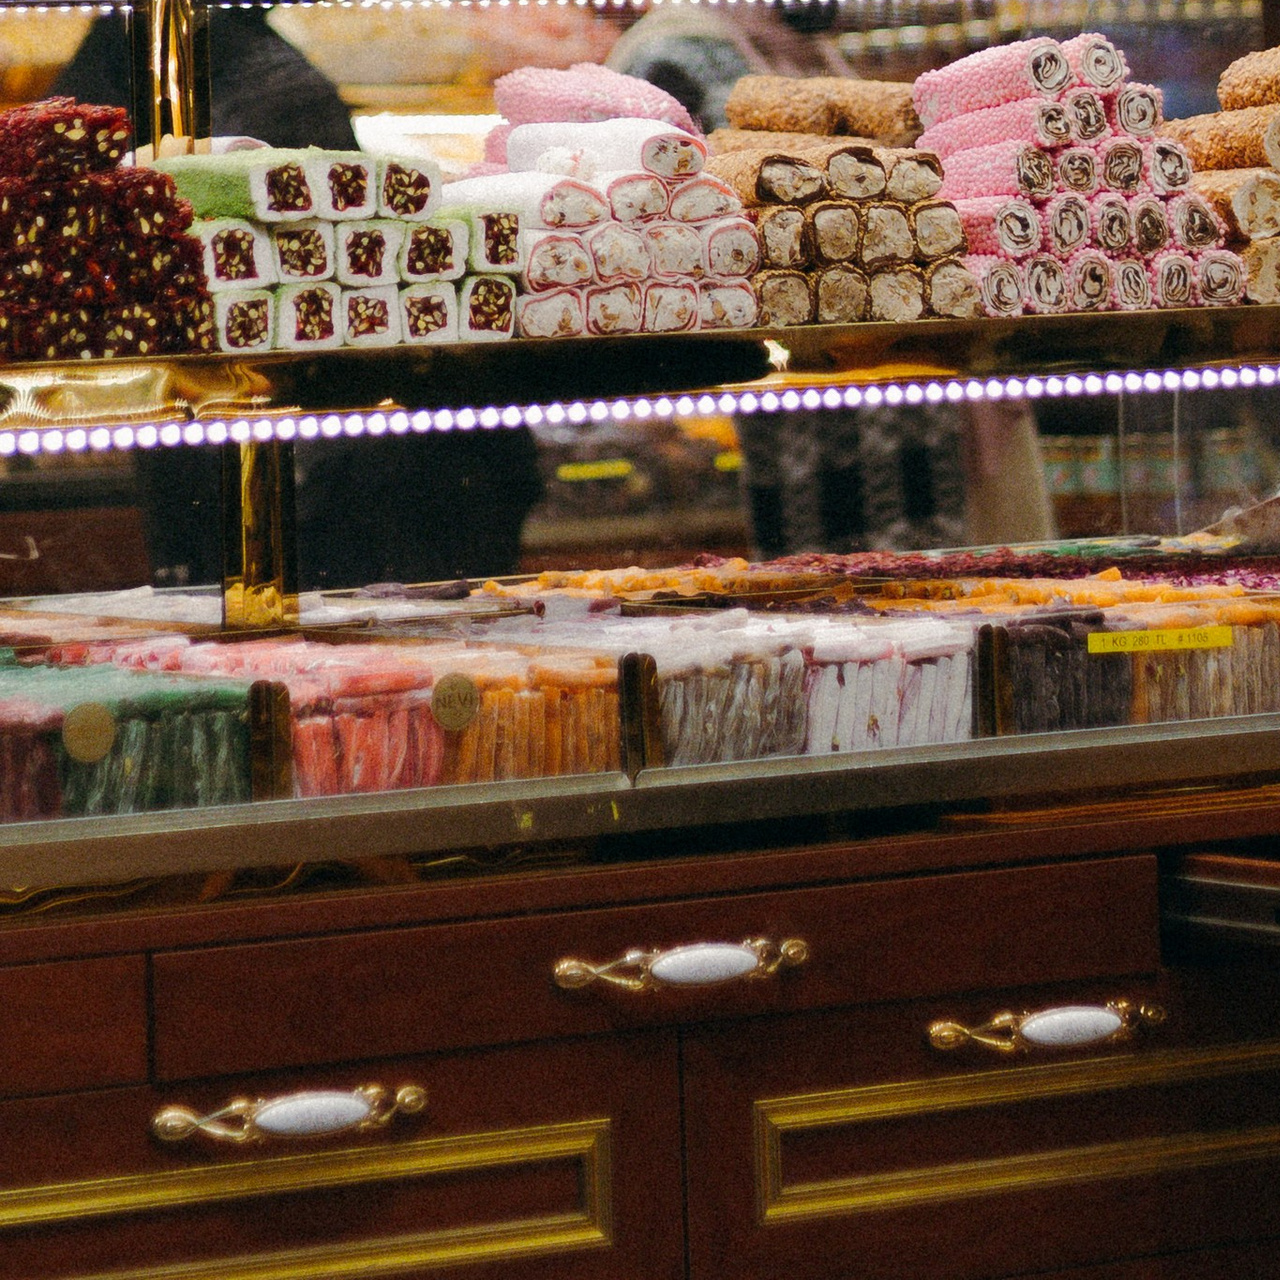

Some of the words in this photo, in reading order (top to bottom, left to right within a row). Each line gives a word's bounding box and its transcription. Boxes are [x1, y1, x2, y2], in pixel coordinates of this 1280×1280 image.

[1111, 636, 1127, 647] KG
[1133, 635, 1150, 646] 280
[1156, 634, 1167, 645] TL
